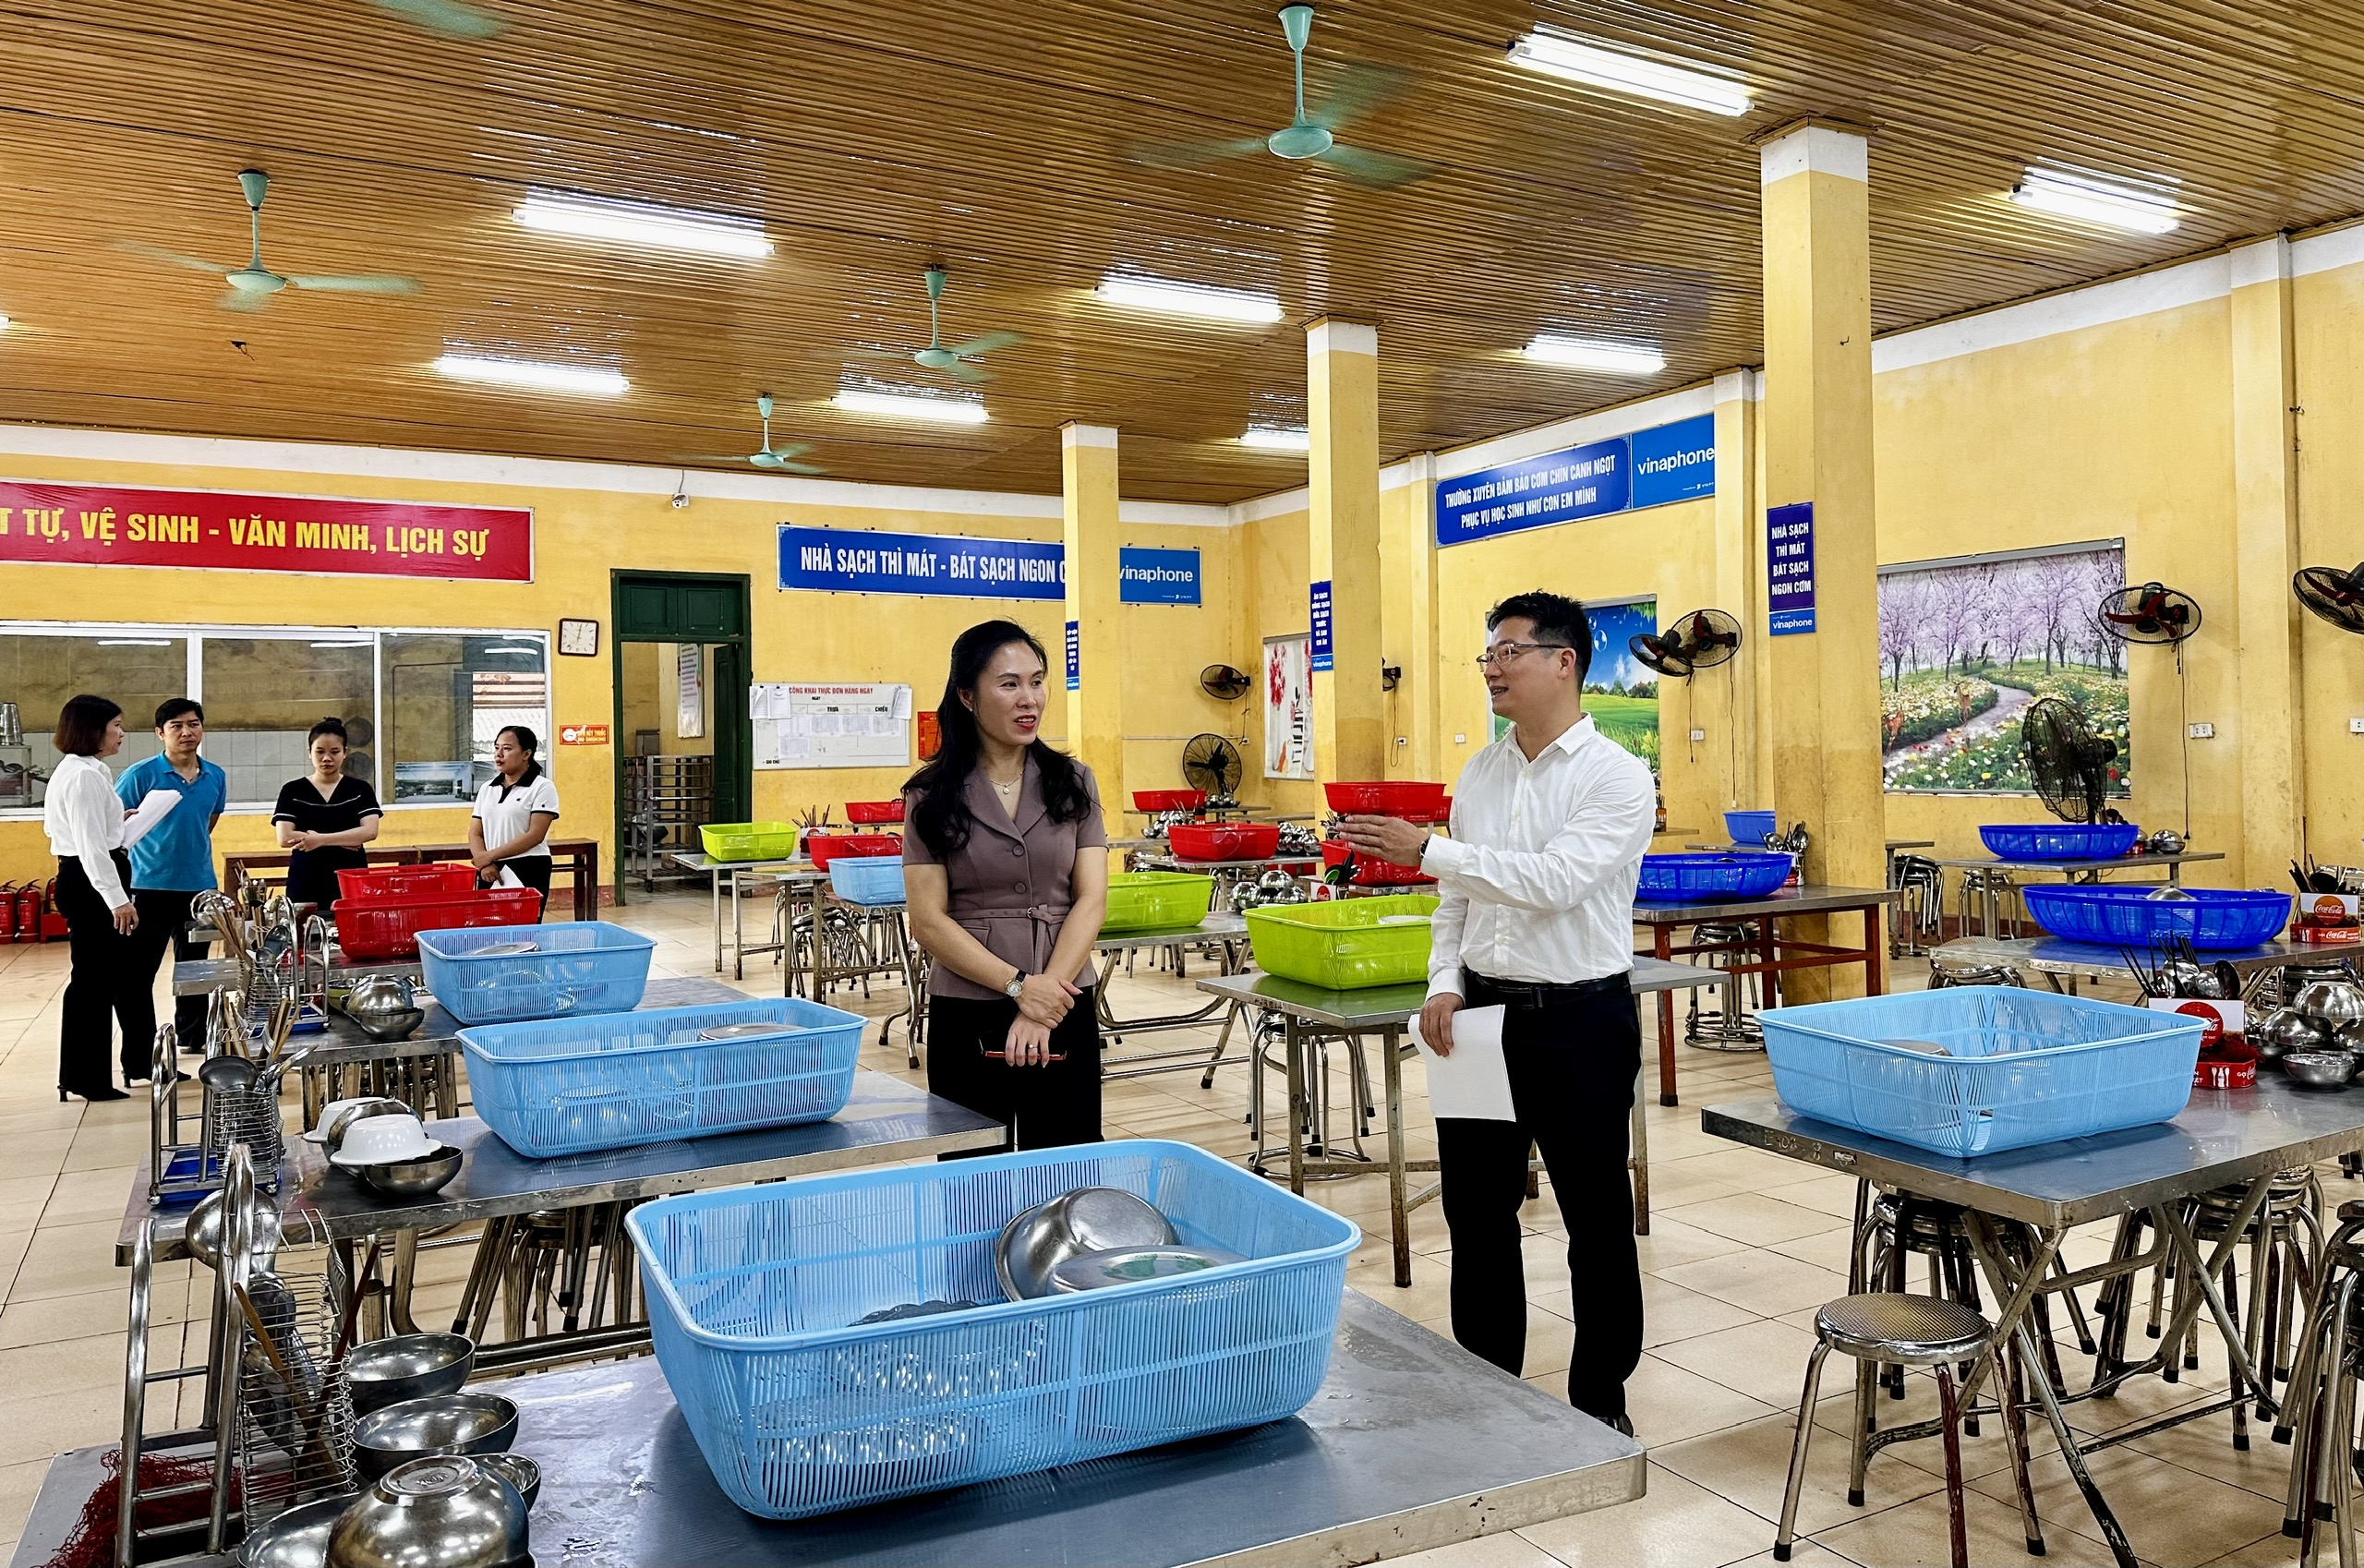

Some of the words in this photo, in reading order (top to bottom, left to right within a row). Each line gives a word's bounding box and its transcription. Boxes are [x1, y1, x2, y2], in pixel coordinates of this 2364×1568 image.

[1637, 447, 1715, 476] vinaphone
[1445, 488, 1472, 508] THƯỜNG
[1473, 481, 1495, 502] XUYÊN
[1497, 476, 1514, 497] ĐẢM
[1514, 472, 1529, 492] BẢO
[1531, 471, 1548, 488] CƠM
[1550, 464, 1568, 485] CHÍN
[1571, 461, 1592, 480] CANH
[1594, 454, 1615, 476] NGỌT
[1461, 512, 1479, 530] PHỤC
[1480, 509, 1490, 526] VỤ
[1491, 506, 1505, 525] HỌC
[1507, 501, 1525, 519] SINH
[1526, 497, 1542, 515] NHƯ
[1543, 494, 1559, 512] CON
[1561, 491, 1573, 509] EM
[1575, 486, 1596, 506] MÌNH
[22, 507, 69, 543] TỰ,
[79, 507, 116, 546] VỆ
[127, 513, 199, 543] SINH
[229, 513, 285, 547] VĂN
[296, 521, 377, 554] MINH,
[386, 526, 444, 558] LỊCH
[452, 529, 489, 561] SỰ
[1771, 524, 1788, 539] NHÀ
[1789, 522, 1809, 538] SẠCH
[1776, 543, 1788, 557] THÌ
[1789, 540, 1805, 555] MÁT
[801, 543, 833, 572] NHÀ
[837, 549, 876, 579] SẠCH
[880, 547, 902, 575] THÌ
[906, 549, 936, 577] MÁT
[949, 550, 976, 580] BÁT
[980, 557, 1016, 585] SẠCH
[1019, 558, 1055, 583] NGON
[1773, 561, 1787, 577] BÁT
[1789, 561, 1809, 576] SẠCH
[1120, 565, 1193, 583] vinaphone
[1771, 582, 1792, 596] NGON
[1793, 580, 1811, 593] CƠM
[1772, 619, 1813, 630] vinaphone
